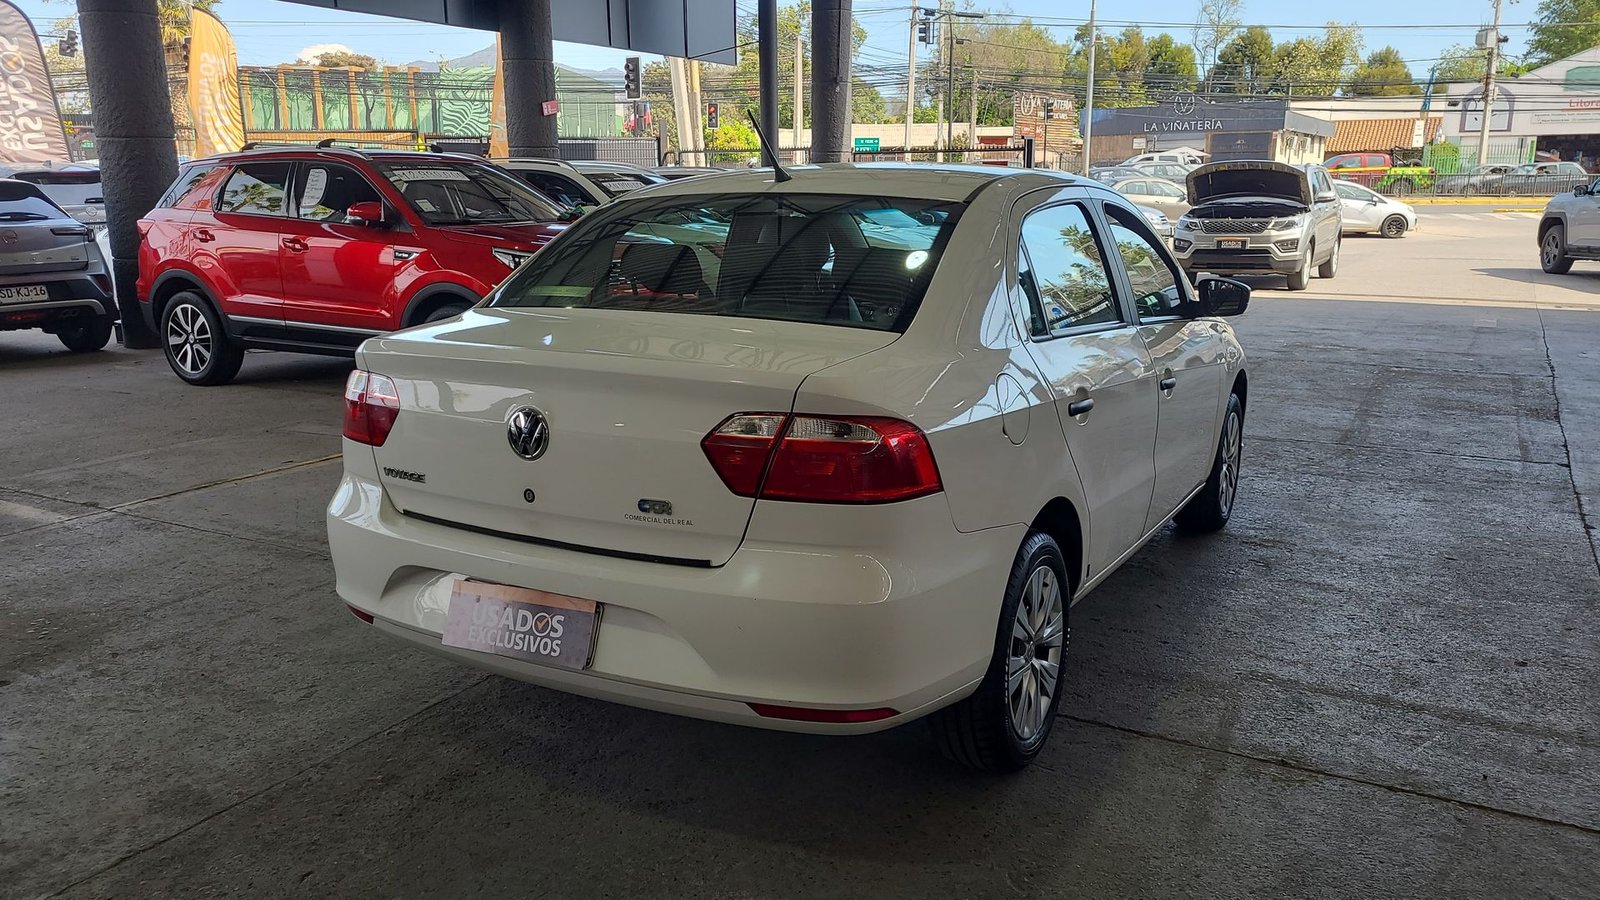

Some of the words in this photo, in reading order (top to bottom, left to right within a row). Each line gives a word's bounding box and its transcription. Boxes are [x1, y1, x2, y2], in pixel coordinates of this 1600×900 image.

[1144, 122, 1158, 132] LA
[1162, 118, 1223, 132] VIÑATERÍA
[383, 466, 426, 484] VOYAGE
[624, 513, 662, 524] COMERCIAL
[472, 604, 565, 638] USADOS
[468, 624, 562, 657] EXCLUSIVOS
